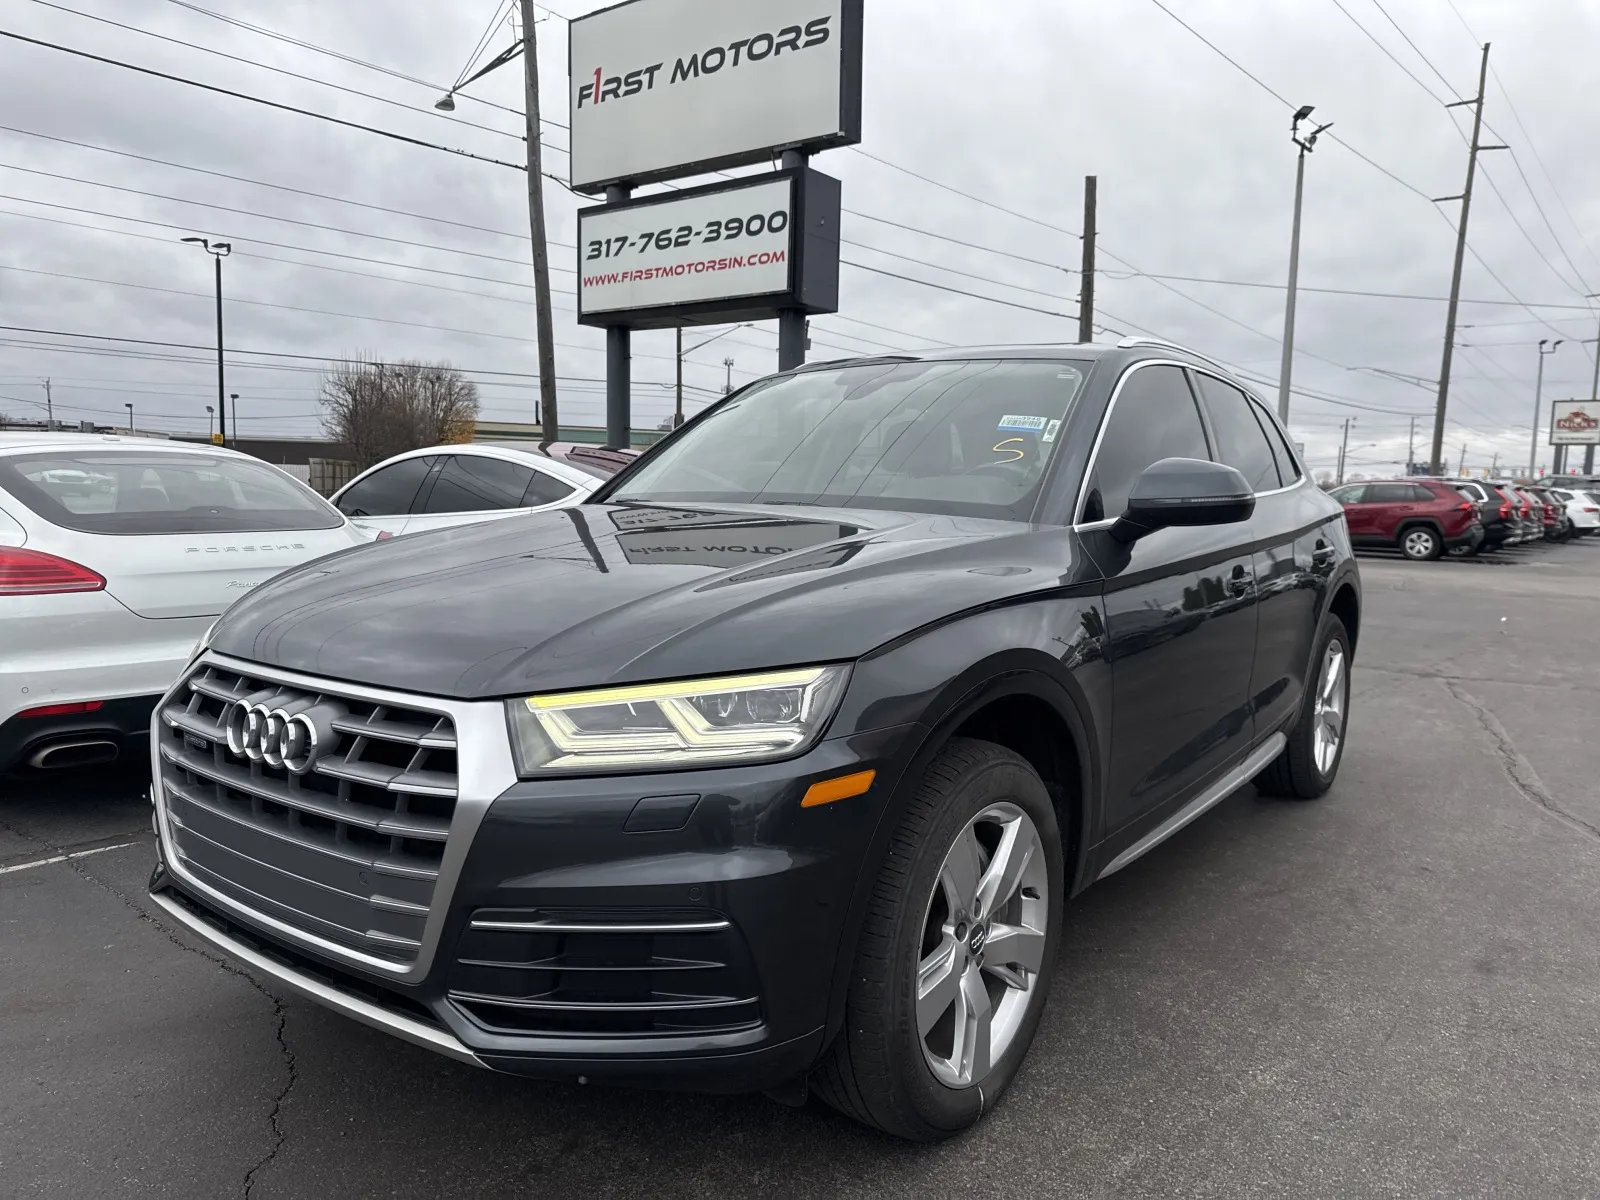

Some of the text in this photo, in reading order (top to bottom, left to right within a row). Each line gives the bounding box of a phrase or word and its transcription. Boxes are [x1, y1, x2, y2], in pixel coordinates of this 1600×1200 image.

[670, 16, 831, 84] MOTORS
[586, 210, 788, 260] 317-762-3900
[583, 251, 785, 288] WWW.FIRSTMOTORSIN.COM
[185, 543, 305, 553] PORSCHE
